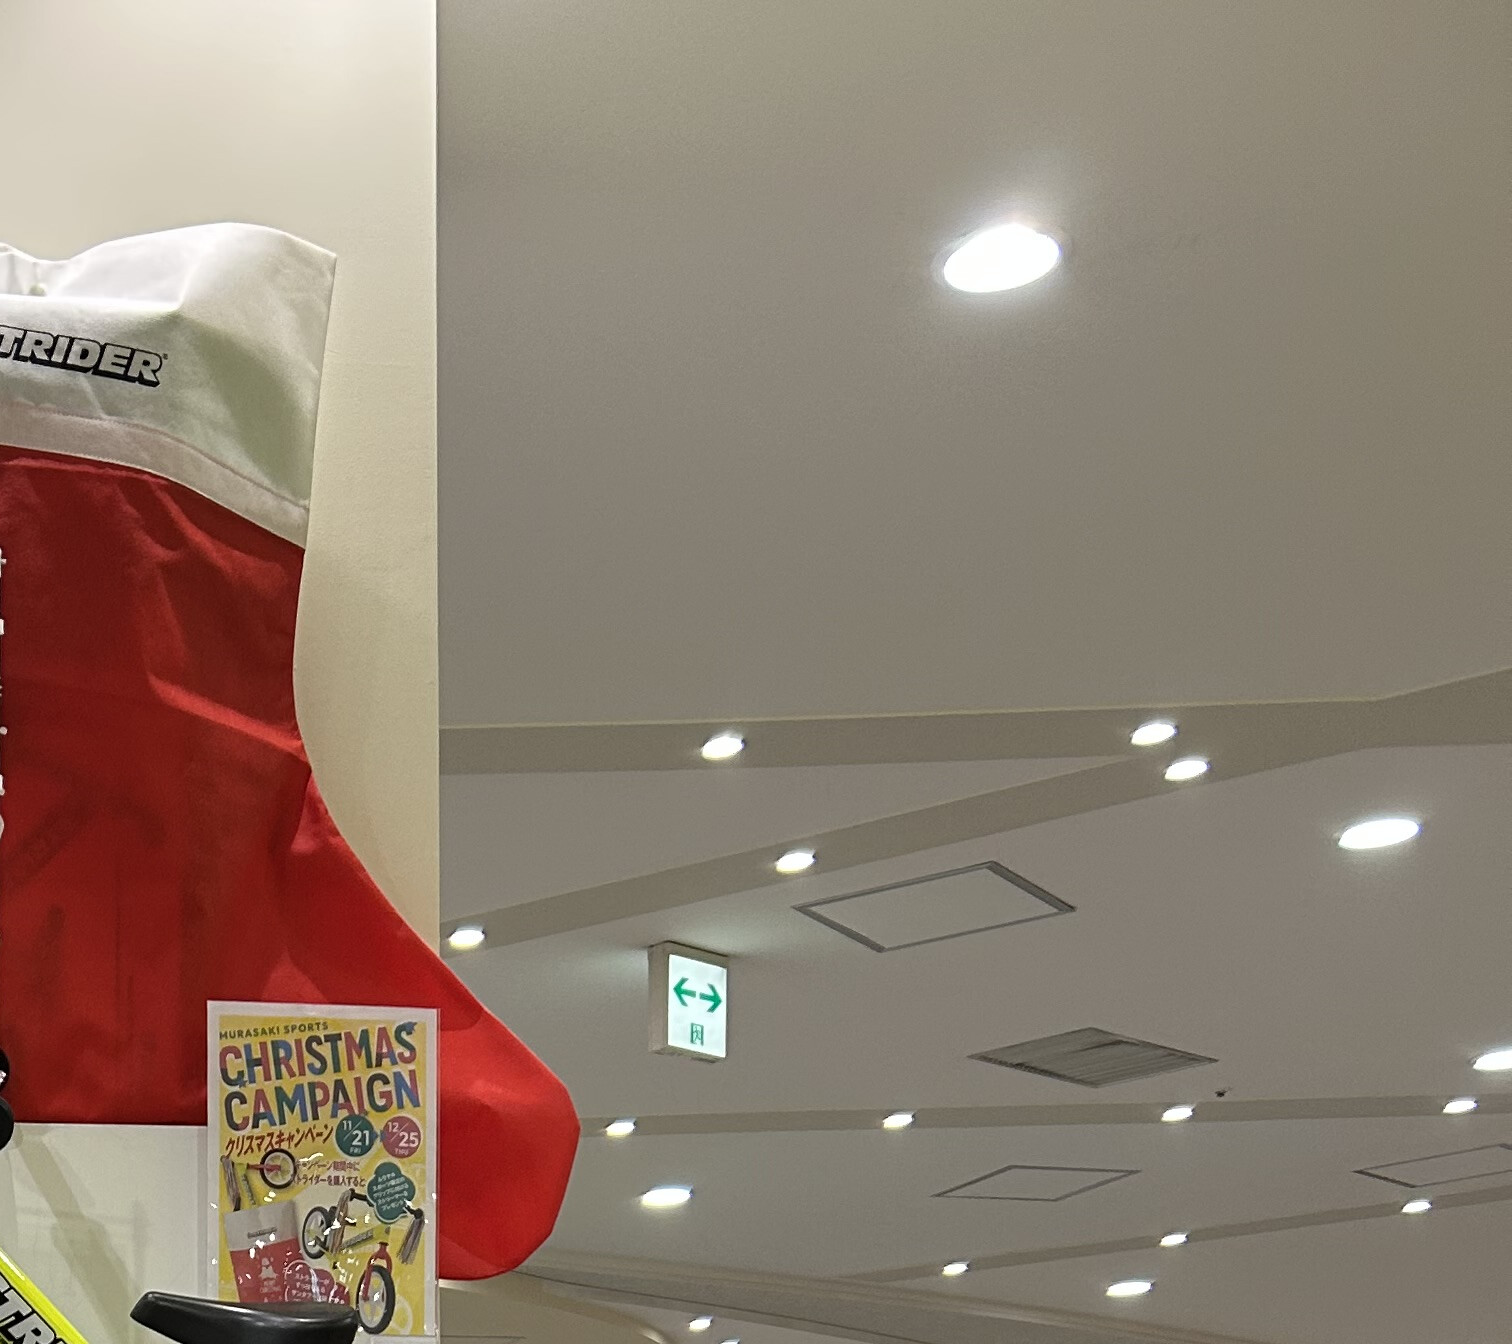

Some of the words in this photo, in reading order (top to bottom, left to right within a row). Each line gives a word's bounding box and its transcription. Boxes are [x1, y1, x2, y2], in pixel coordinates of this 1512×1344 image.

[219, 1026, 280, 1040] MURASAKI
[284, 1021, 329, 1033] SPORTS
[219, 1021, 418, 1088] CHRISTMAS
[224, 1069, 421, 1132] CAMPAIGN
[225, 1124, 334, 1157] クリスマスキャンペーン
